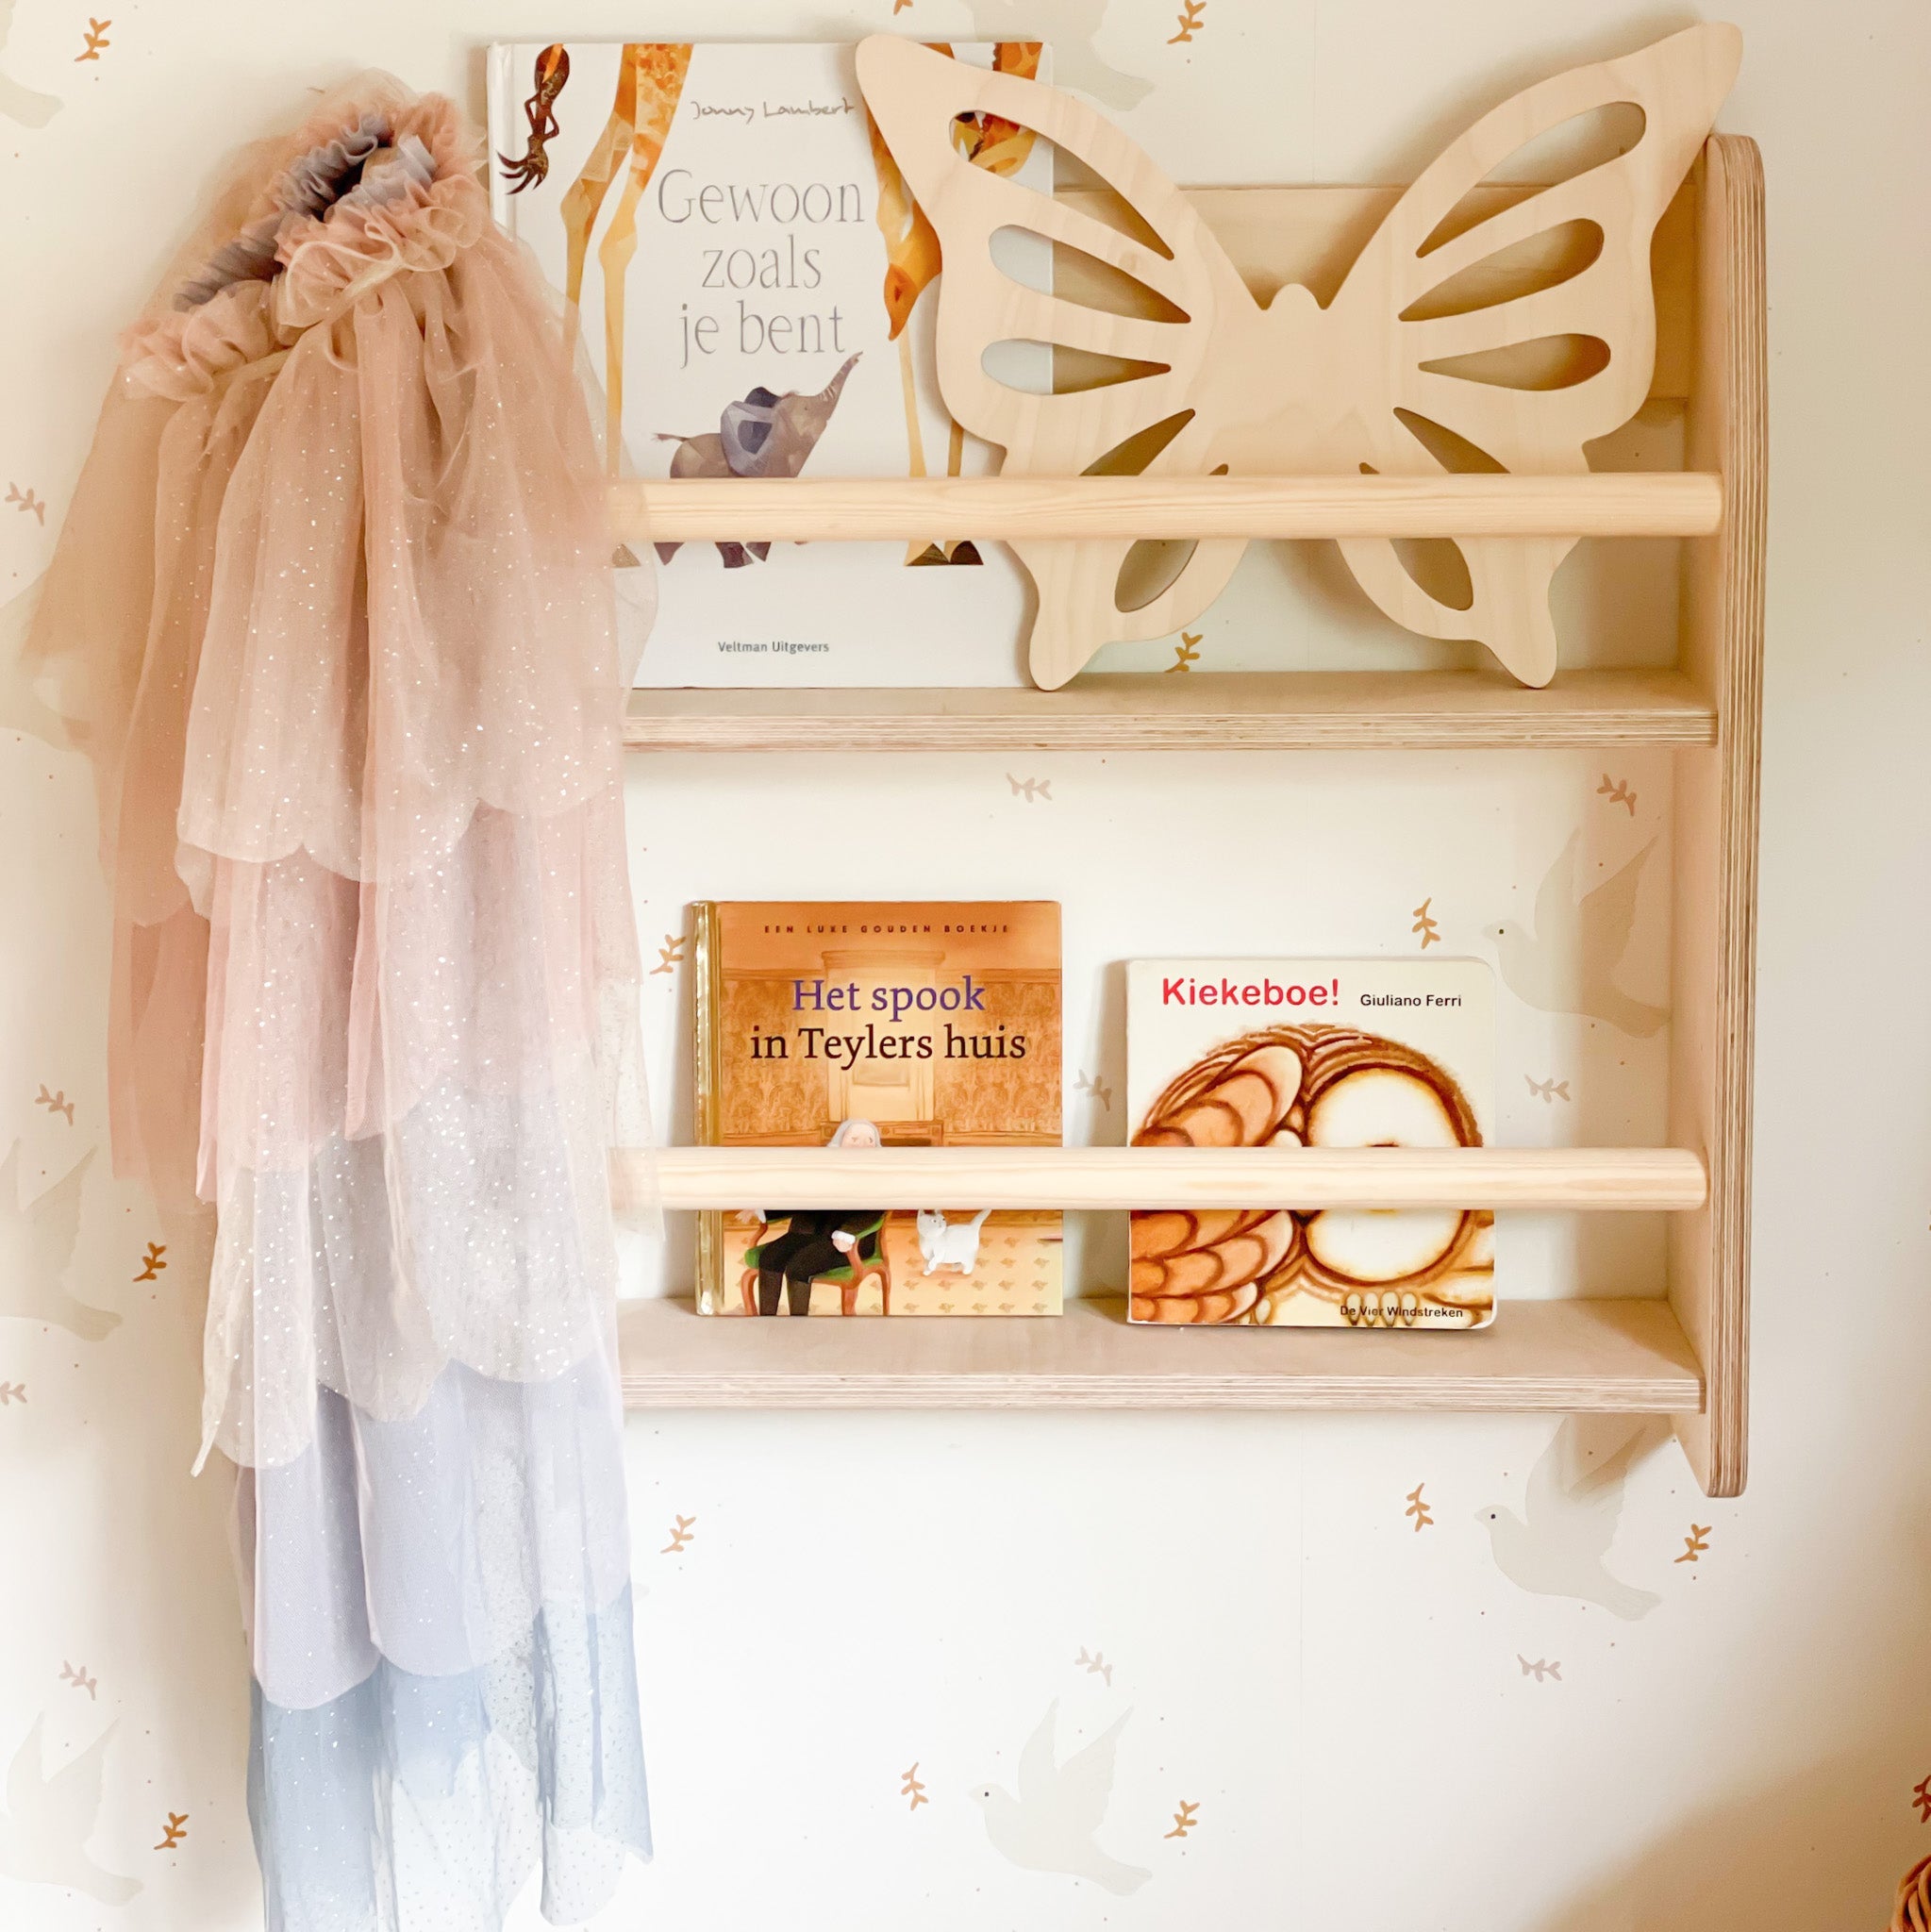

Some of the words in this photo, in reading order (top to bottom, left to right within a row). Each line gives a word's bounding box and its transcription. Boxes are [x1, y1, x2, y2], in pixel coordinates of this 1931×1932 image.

[762, 96, 855, 119] Lambert
[658, 168, 865, 224] Gewoon
[701, 234, 822, 290] zoals
[679, 303, 720, 369] je
[738, 300, 847, 355] bent
[718, 641, 768, 653] Veltman
[772, 641, 830, 655] Uitgevers
[764, 924, 794, 934] EEN
[807, 924, 848, 934] LUXE
[860, 924, 931, 934] GOUDEN
[943, 924, 1008, 934] BOEKJE
[791, 979, 861, 1012] Het
[871, 975, 986, 1023] spook
[1162, 977, 1339, 1007] Kiekeboe!
[1359, 993, 1422, 1008] Giuliano
[1426, 993, 1462, 1008] Ferri
[750, 1025, 789, 1059] in
[797, 1024, 933, 1071] Teylers
[943, 1024, 1026, 1058] huis
[1340, 1306, 1357, 1316] De
[1359, 1306, 1383, 1317] Vier
[1387, 1306, 1463, 1318] Windstreken
